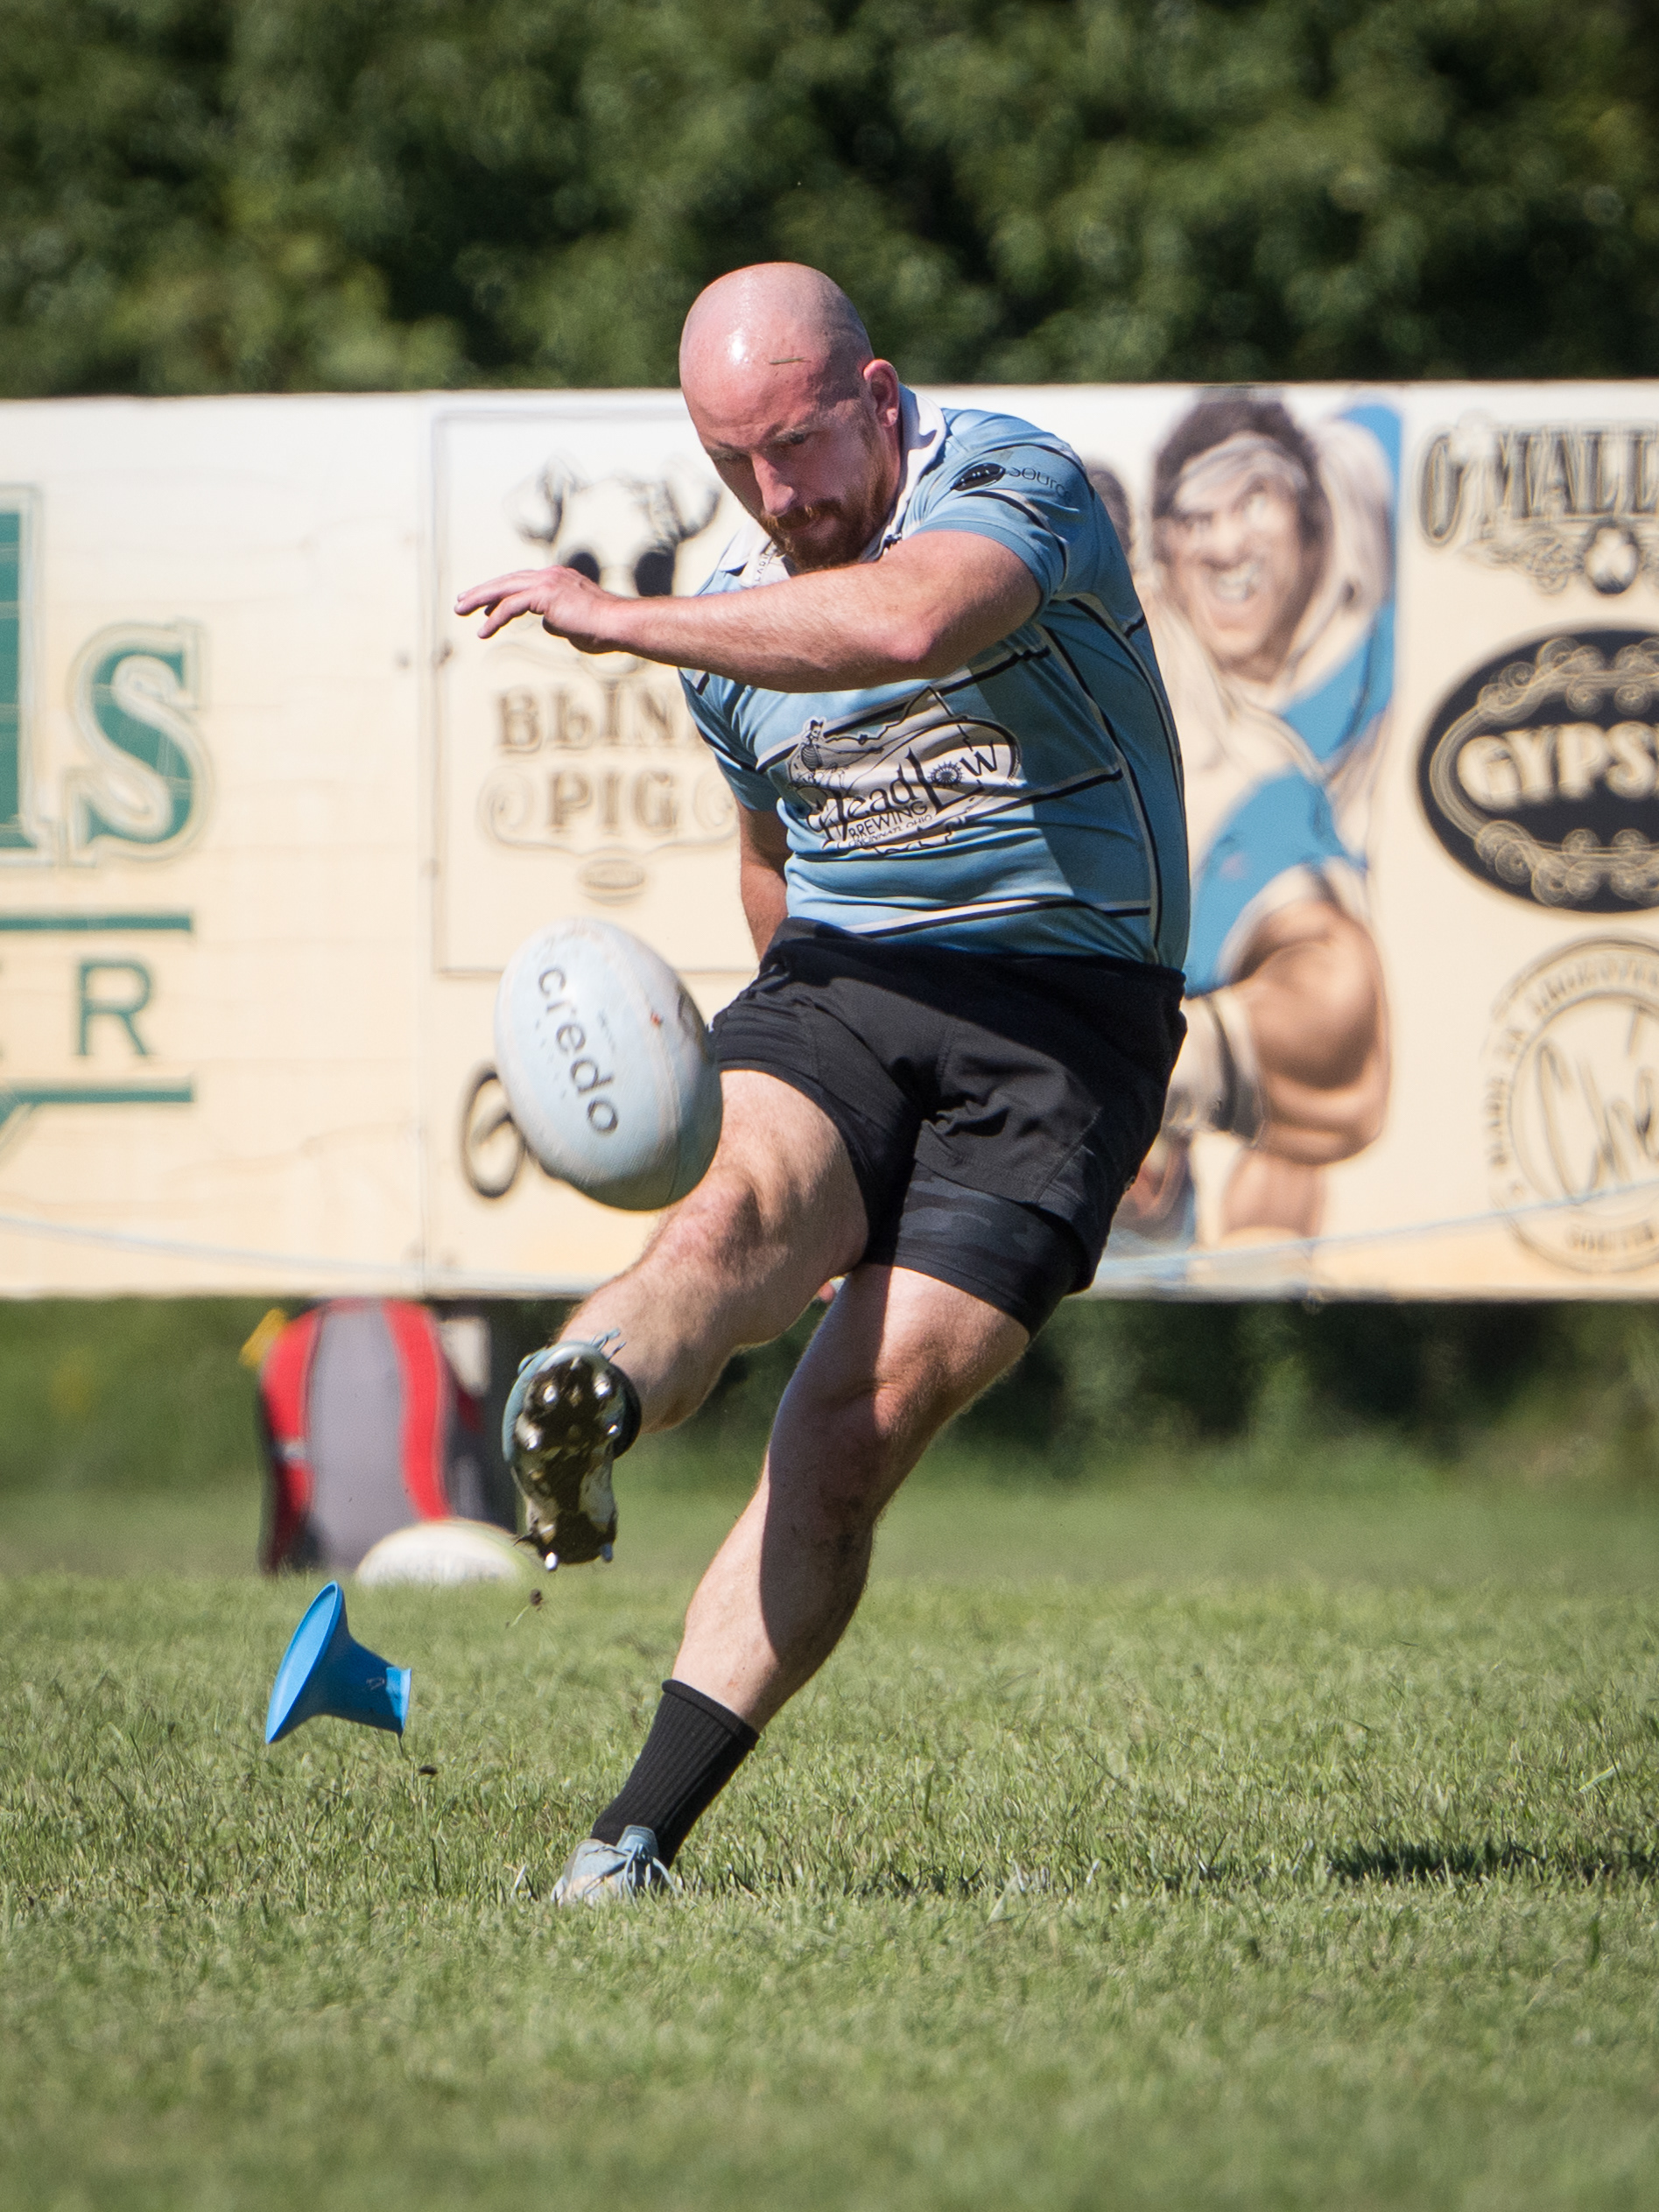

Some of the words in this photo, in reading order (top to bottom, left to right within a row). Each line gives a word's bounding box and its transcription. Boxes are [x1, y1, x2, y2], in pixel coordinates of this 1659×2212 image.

[543, 763, 679, 836] PIG
[1456, 720, 1659, 814] GYPS
[847, 799, 929, 842] BREWING
[538, 966, 619, 1136] credo
